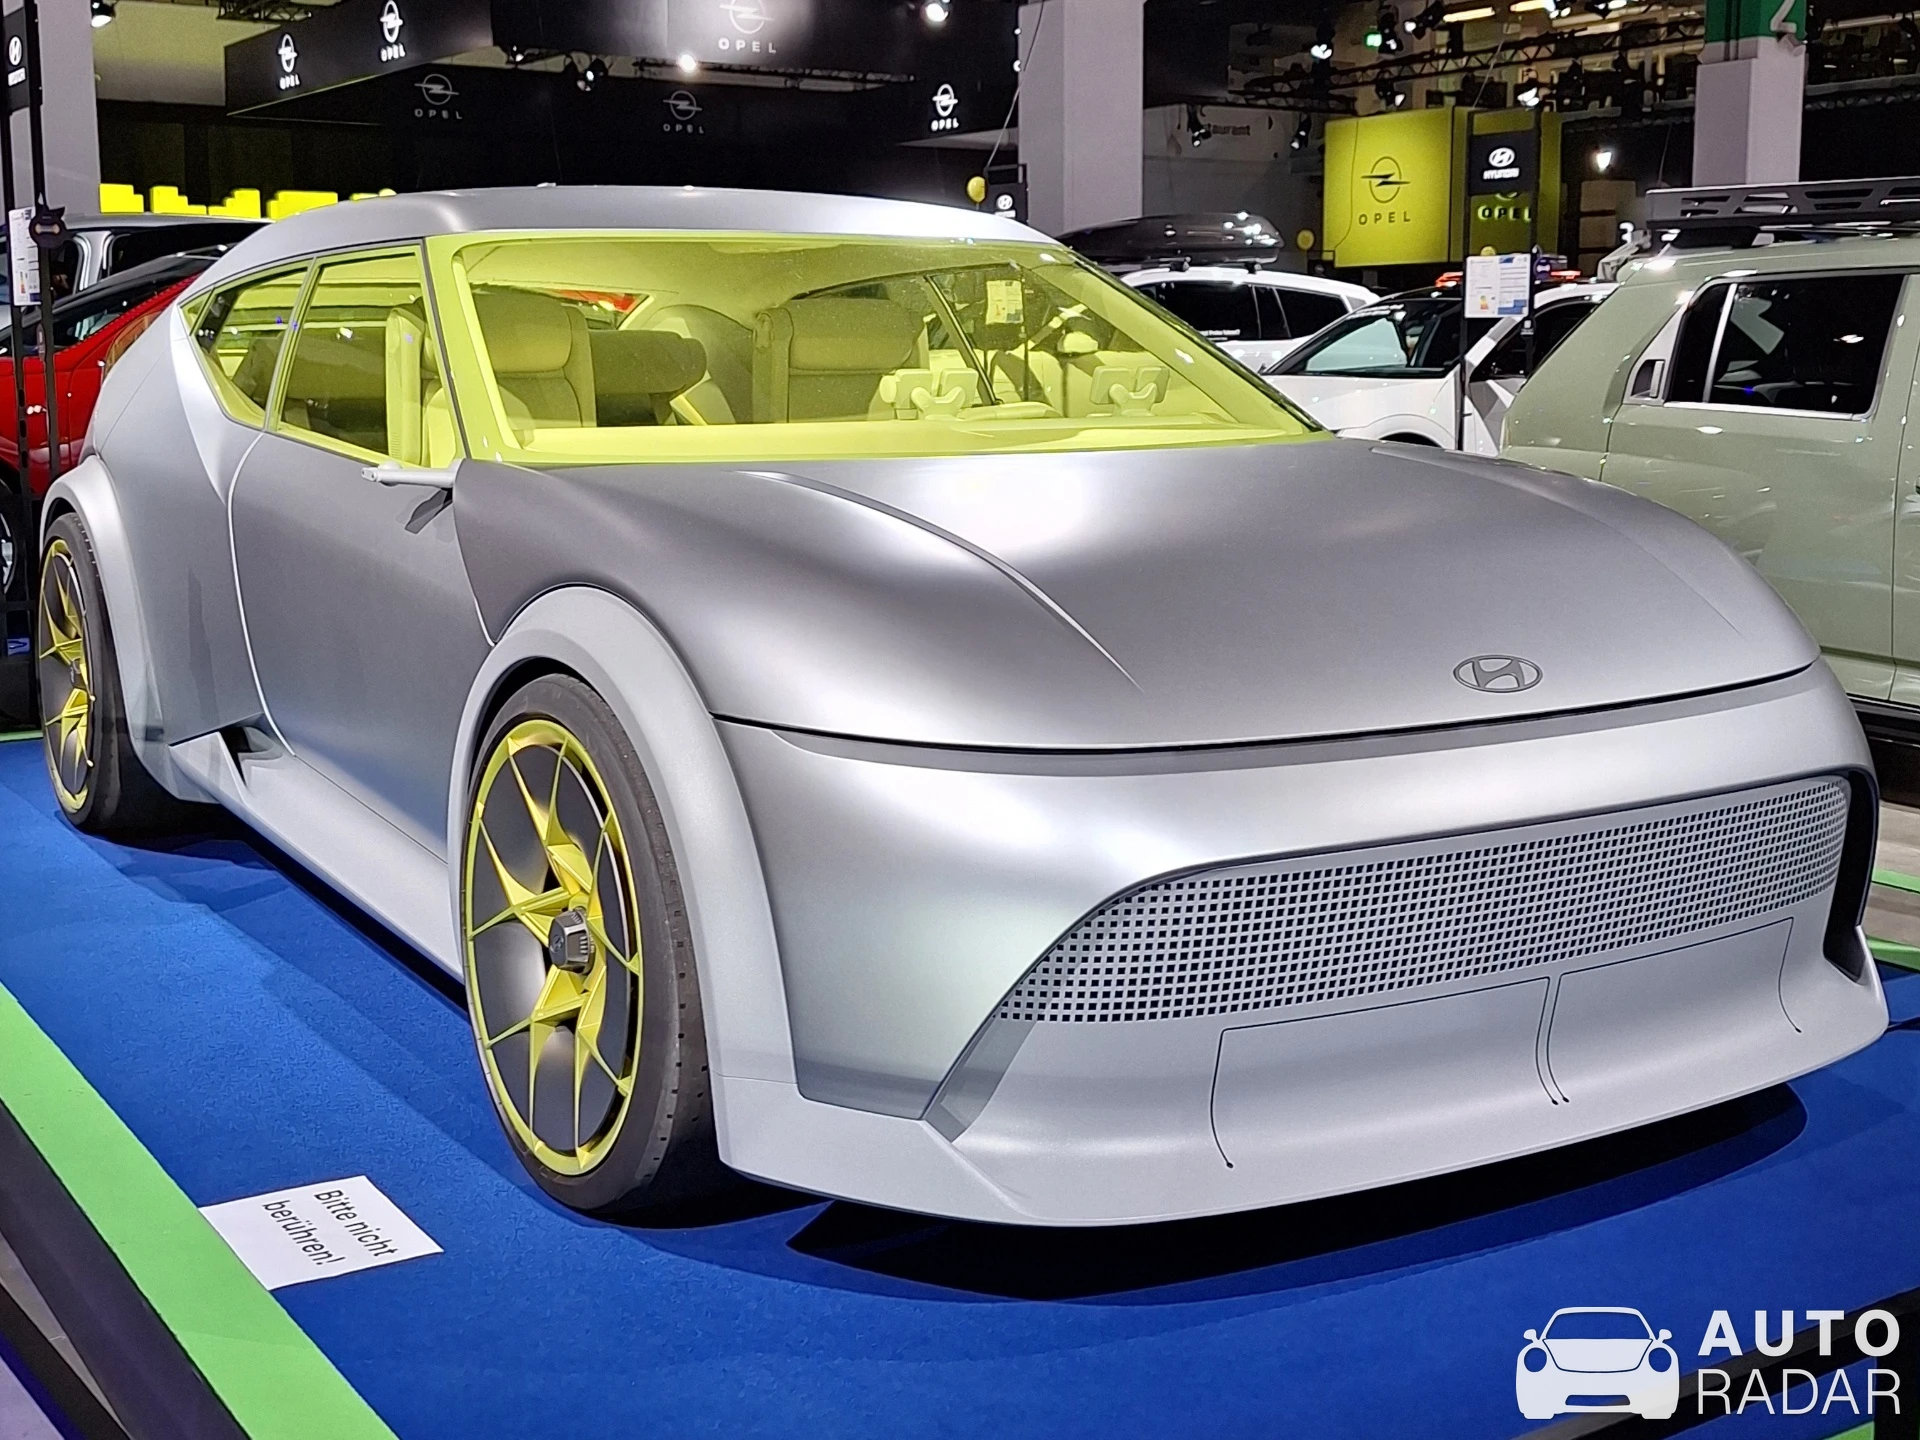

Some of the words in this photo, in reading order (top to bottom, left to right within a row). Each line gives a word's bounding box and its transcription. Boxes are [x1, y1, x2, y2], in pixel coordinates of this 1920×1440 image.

[380, 43, 406, 62] OPEL
[718, 37, 777, 54] OPEL
[280, 74, 300, 90] OPEL
[414, 108, 463, 120] OPEL
[663, 123, 705, 134] OPEL
[931, 117, 960, 131] OPEL
[1358, 211, 1411, 226] OPEL
[314, 1189, 357, 1222] Bitte
[345, 1221, 399, 1258] nicht
[262, 1200, 346, 1265] berühren!
